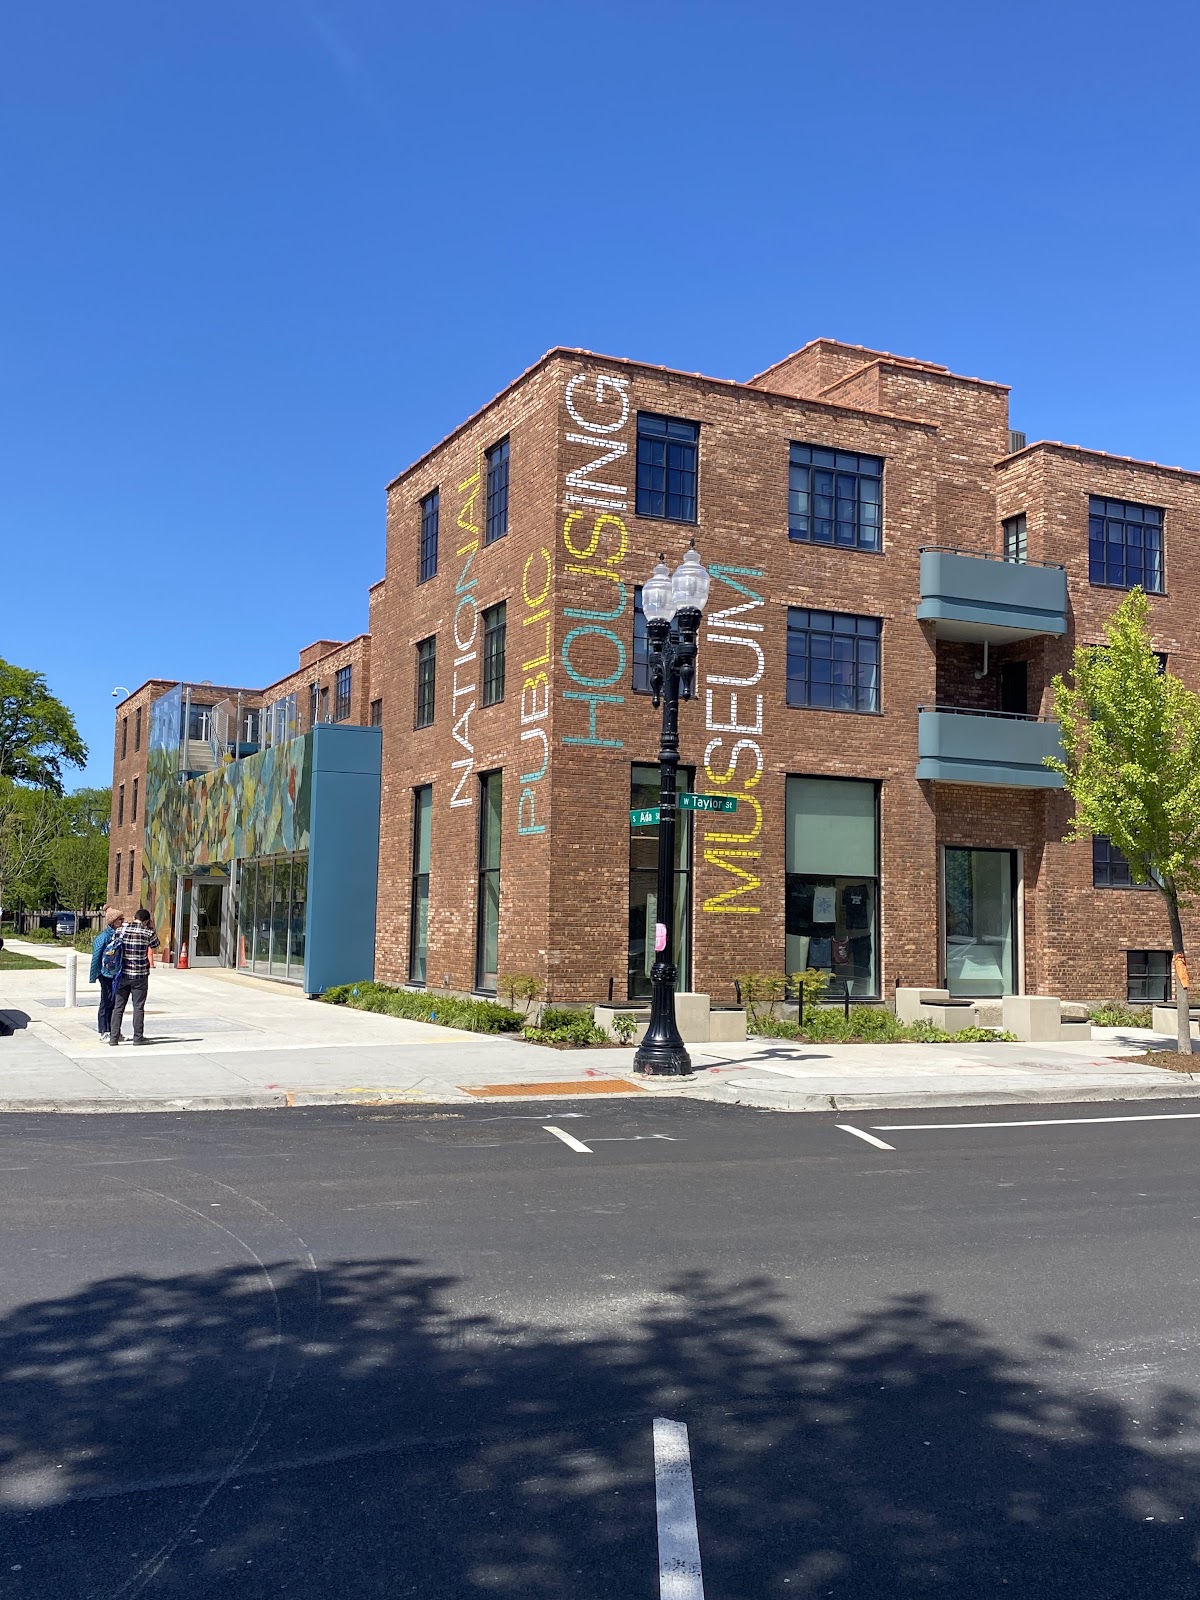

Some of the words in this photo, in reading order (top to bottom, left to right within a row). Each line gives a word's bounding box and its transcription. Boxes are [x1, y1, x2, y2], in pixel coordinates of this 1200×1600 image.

[450, 441, 481, 808] NATIONAL
[517, 546, 552, 835] PUBLIC
[561, 373, 629, 747] HOUSING
[632, 815, 637, 823] S
[640, 811, 652, 823] Ada
[683, 797, 690, 805] W
[692, 796, 723, 810] Taylor
[725, 801, 733, 809] St
[703, 564, 765, 914] MUSEUM
